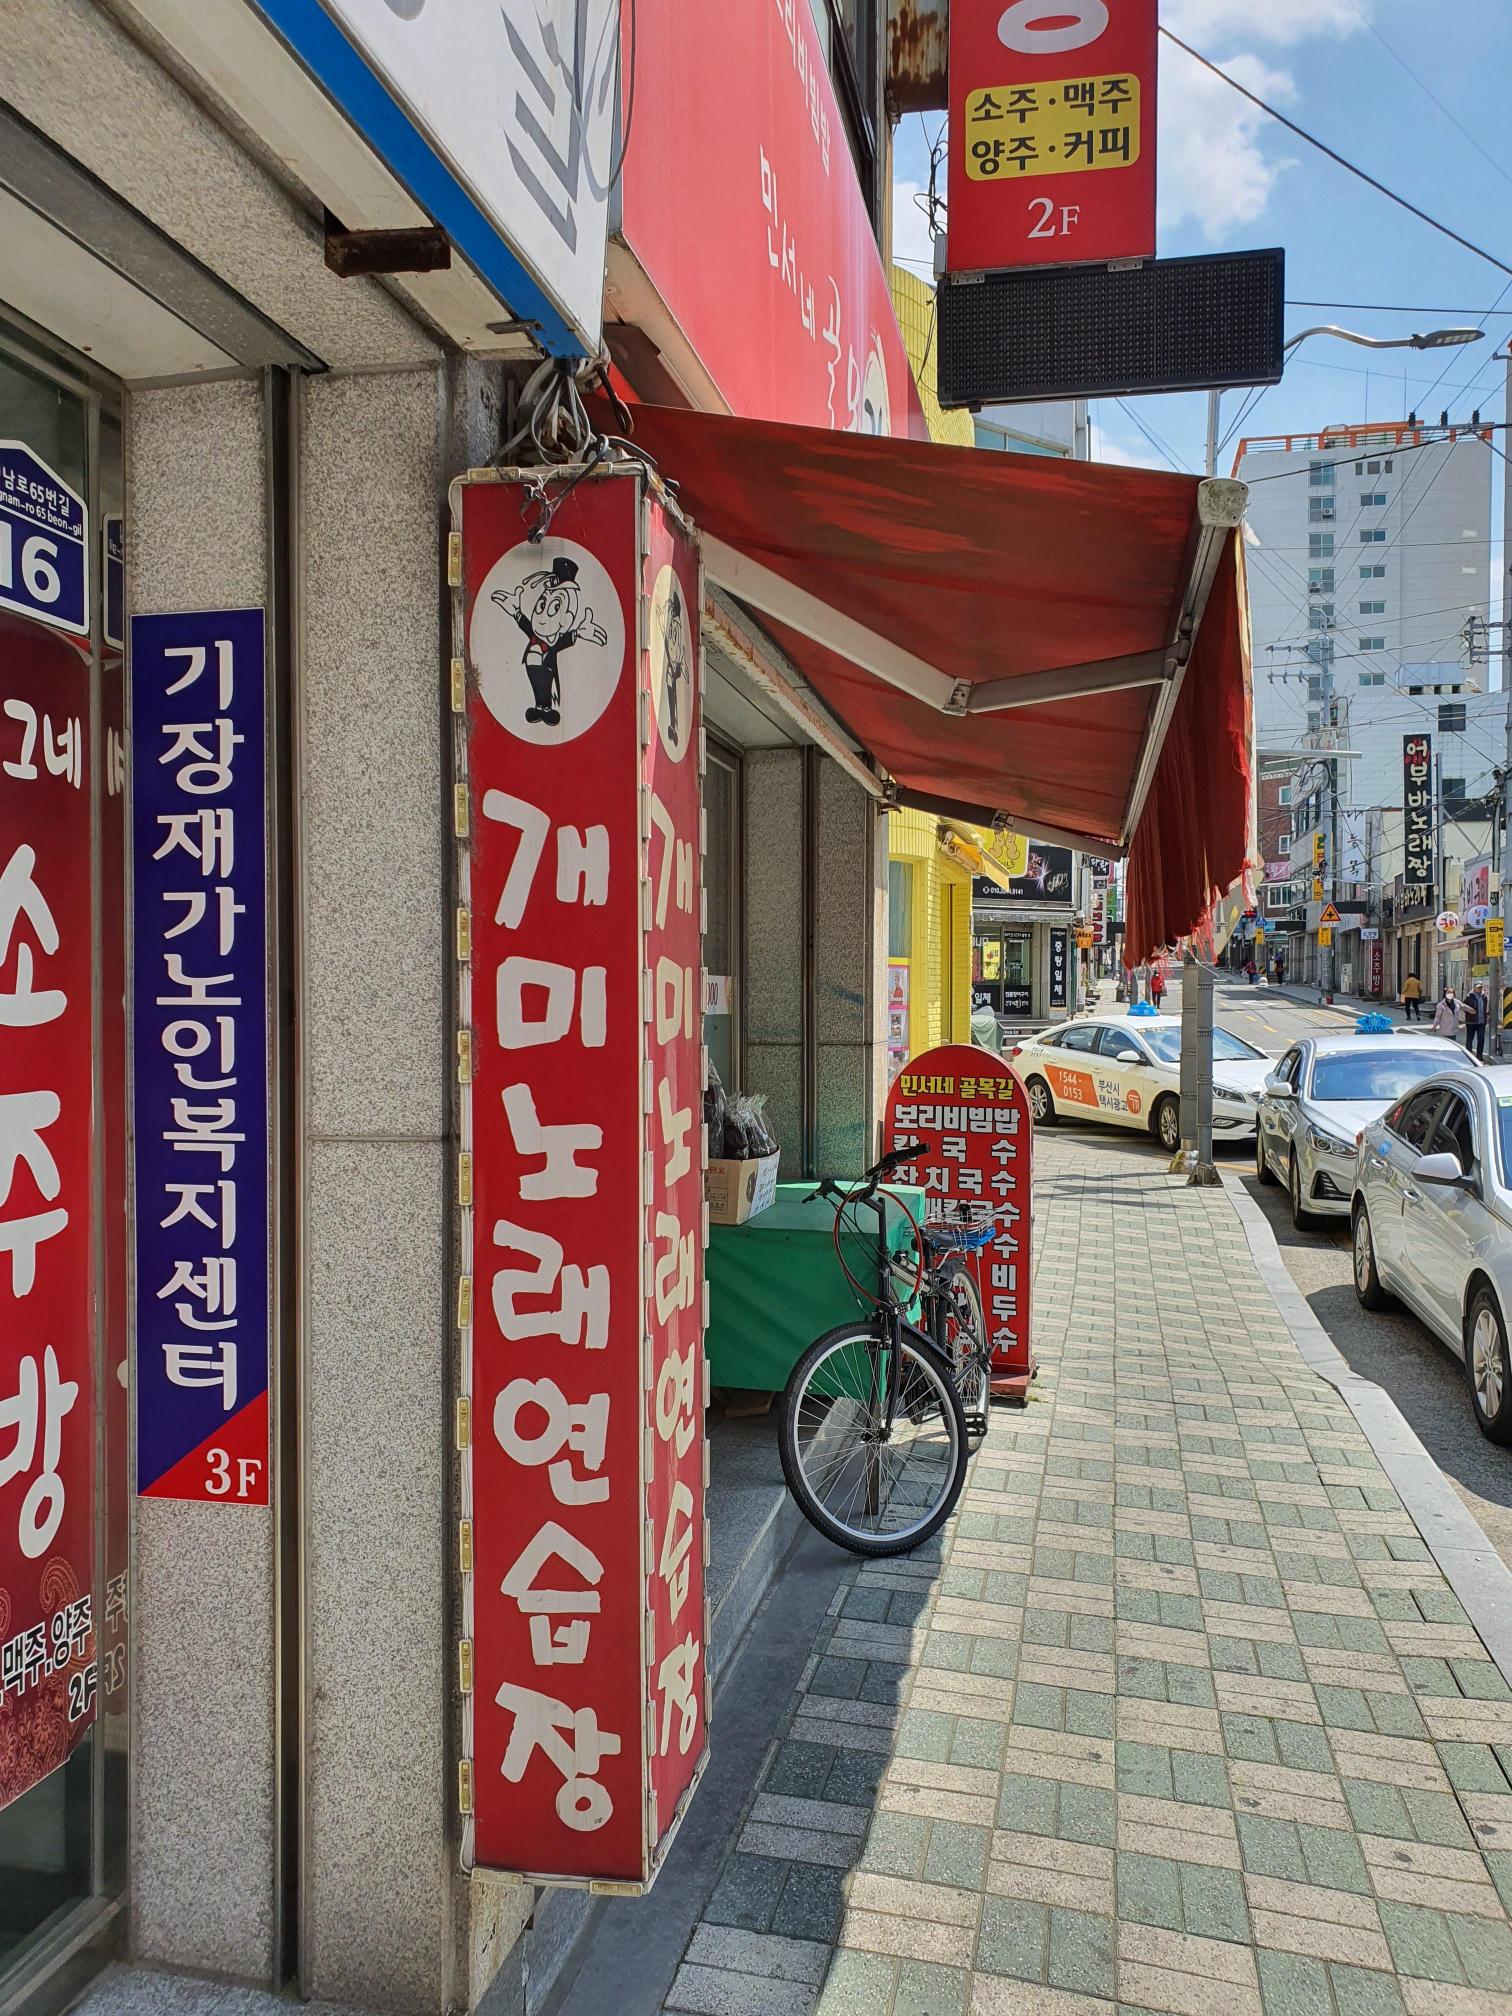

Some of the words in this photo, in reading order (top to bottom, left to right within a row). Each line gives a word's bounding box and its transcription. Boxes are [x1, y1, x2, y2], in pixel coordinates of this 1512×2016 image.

[776, 0, 830, 181] 리비빔밥
[1027, 197, 1080, 239] 2F
[0, 466, 70, 518] 남로65번길
[36, 504, 46, 520] 65
[47, 510, 82, 537] beon-gil
[152, 640, 246, 1411] 기장재가노인복지센터
[900, 1075, 955, 1097] 민서네
[959, 1077, 1015, 1101] 골목길
[1063, 1086, 1083, 1100] 0153
[1098, 1080, 1120, 1095] 부산시
[1099, 1095, 1129, 1112] 택시광고
[894, 1104, 1021, 1135] 보리비빔밥
[651, 793, 701, 1758] 개미노래연습장
[483, 788, 622, 1833] 개미노래연습장
[204, 1447, 262, 1497] 3F
[68, 1663, 97, 1723] 2F
